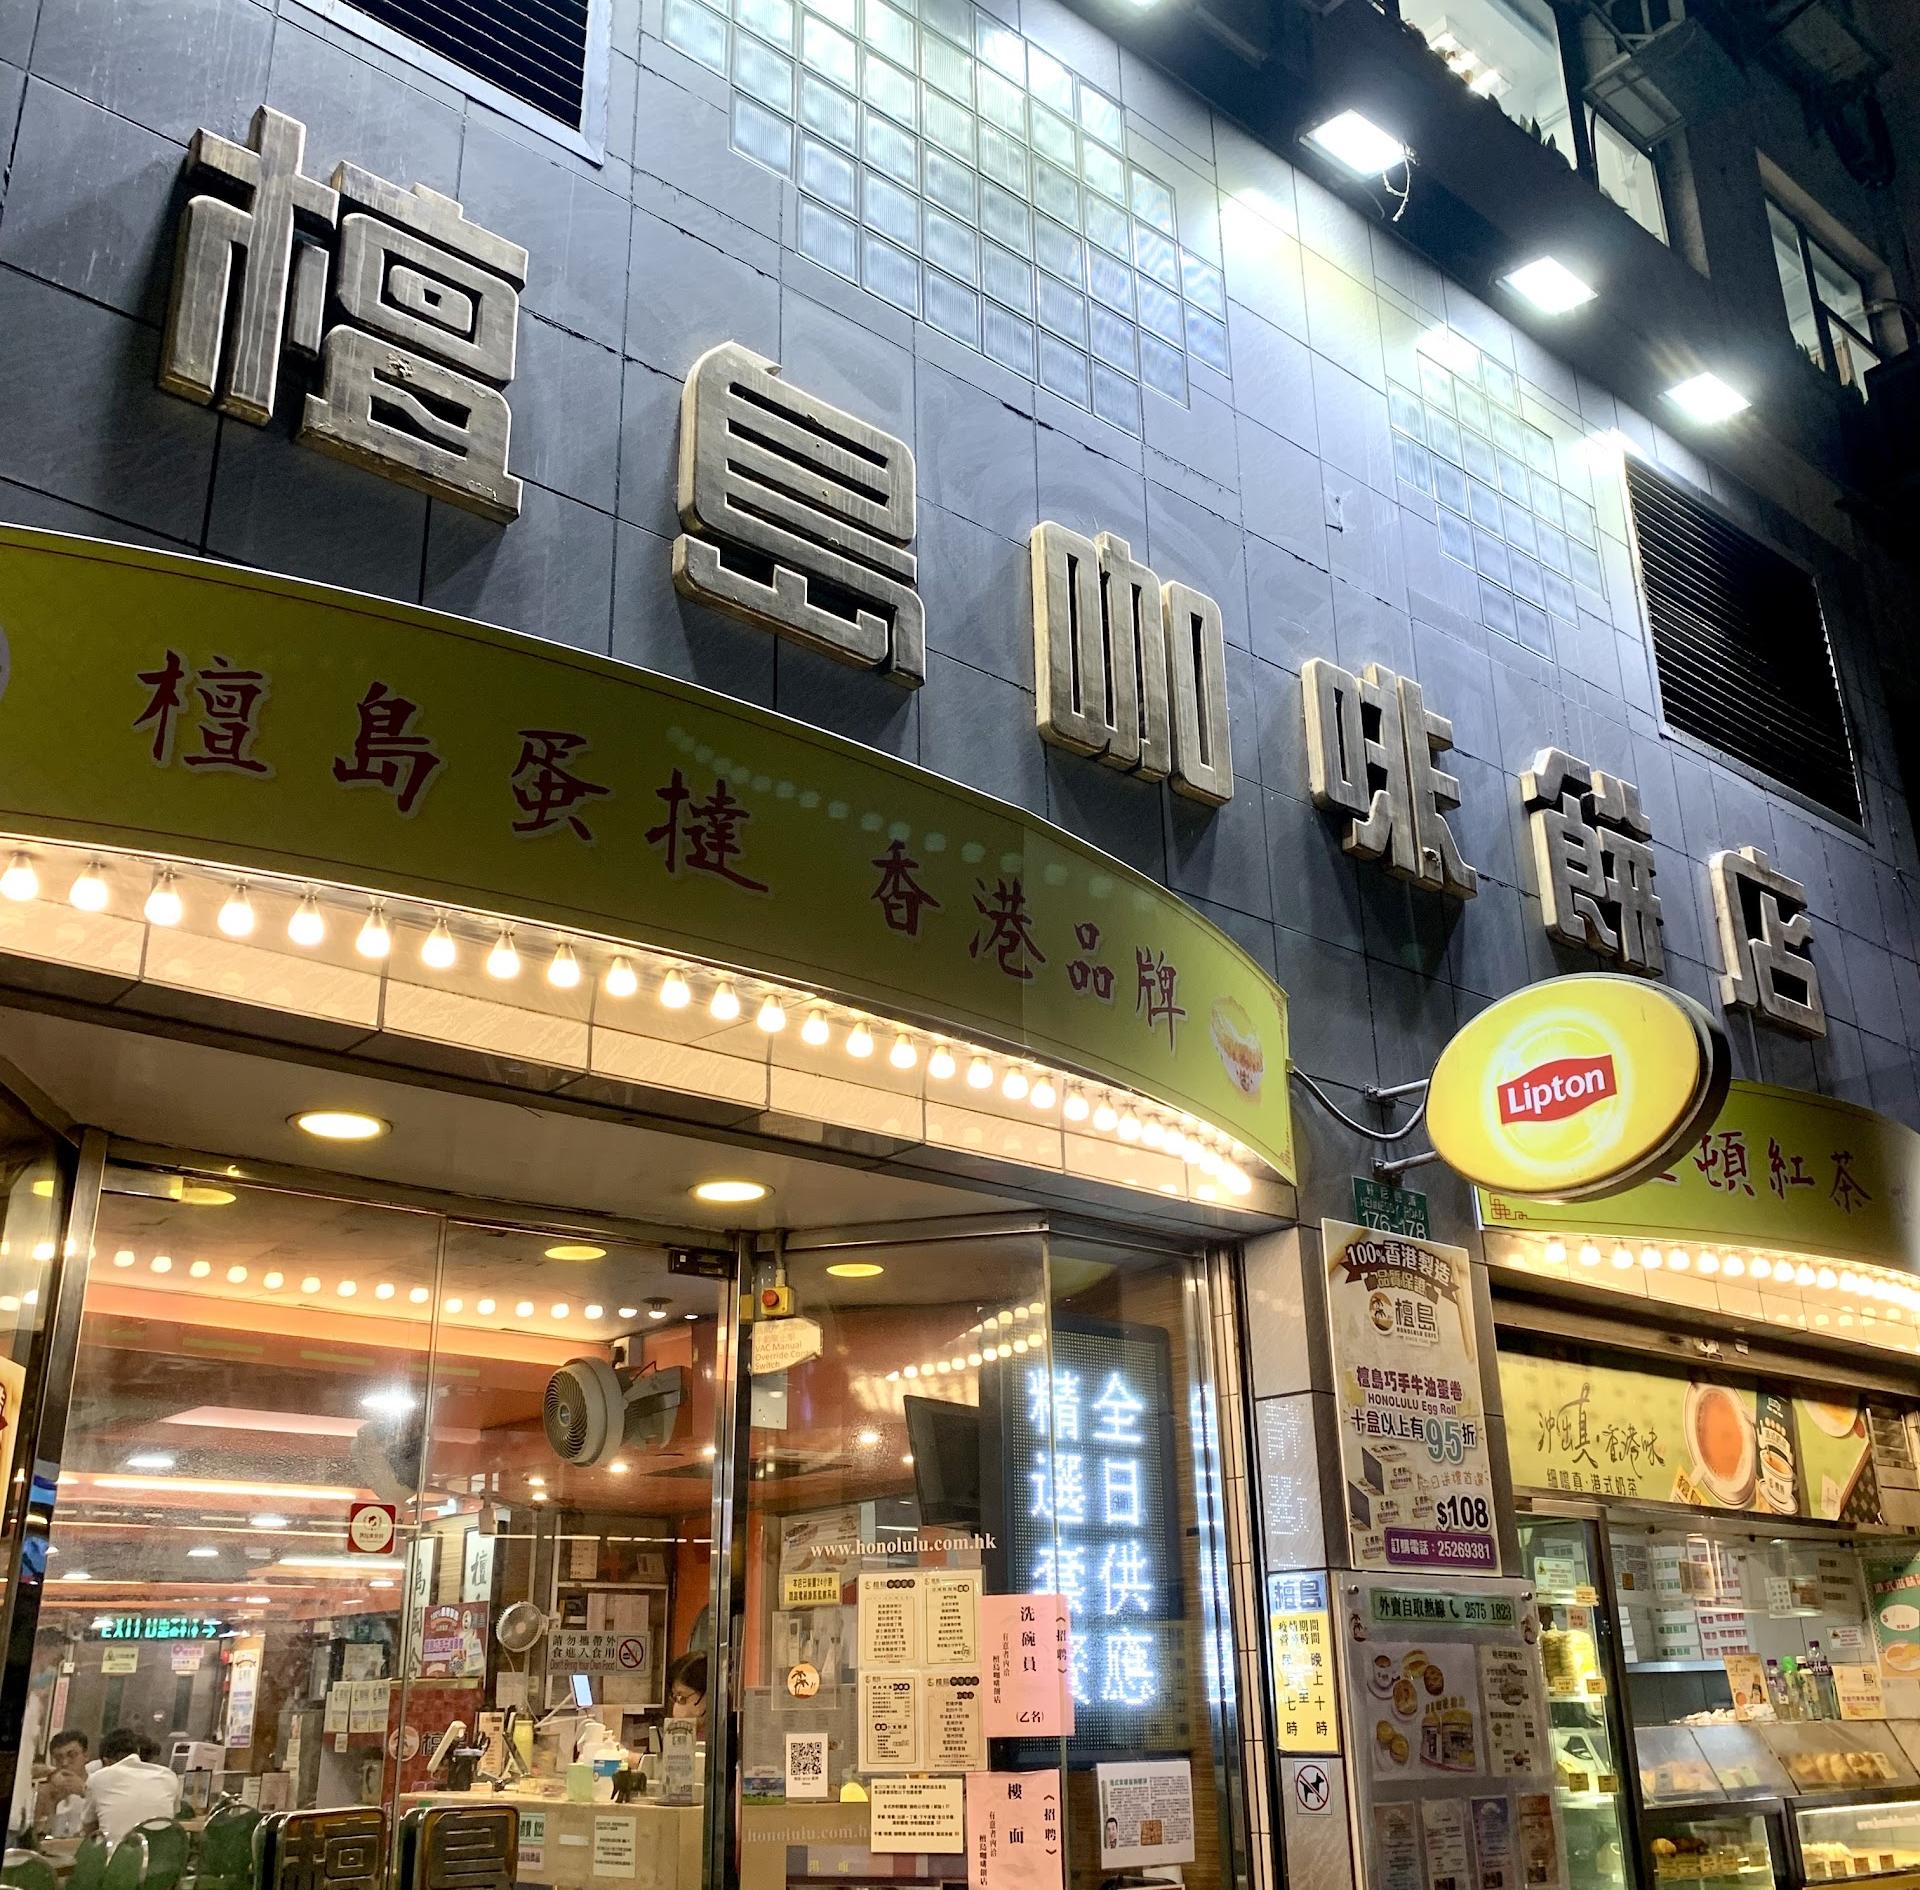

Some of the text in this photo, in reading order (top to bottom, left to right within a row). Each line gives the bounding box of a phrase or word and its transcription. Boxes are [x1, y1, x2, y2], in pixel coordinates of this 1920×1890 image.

[132, 648, 1188, 1052] 檀島蛋撻 香港品牌
[1507, 1068, 1606, 1115] Lipton
[1655, 1131, 1873, 1215] 頓紅茶
[1395, 1298, 1436, 1332] 檀島
[755, 1351, 789, 1362] Override
[772, 1340, 802, 1351] Manual
[755, 1361, 780, 1370] Switch
[1368, 1393, 1457, 1415] HONOLULU Egg Roll
[1436, 1495, 1489, 1528] $108
[809, 1532, 997, 1558] www.honolulu.com.hk
[1092, 1372, 1156, 1705] 全日供應
[1464, 1600, 1487, 1620] 2575
[1490, 1602, 1512, 1621] 1823
[1020, 1606, 1036, 1672] 洗碗員
